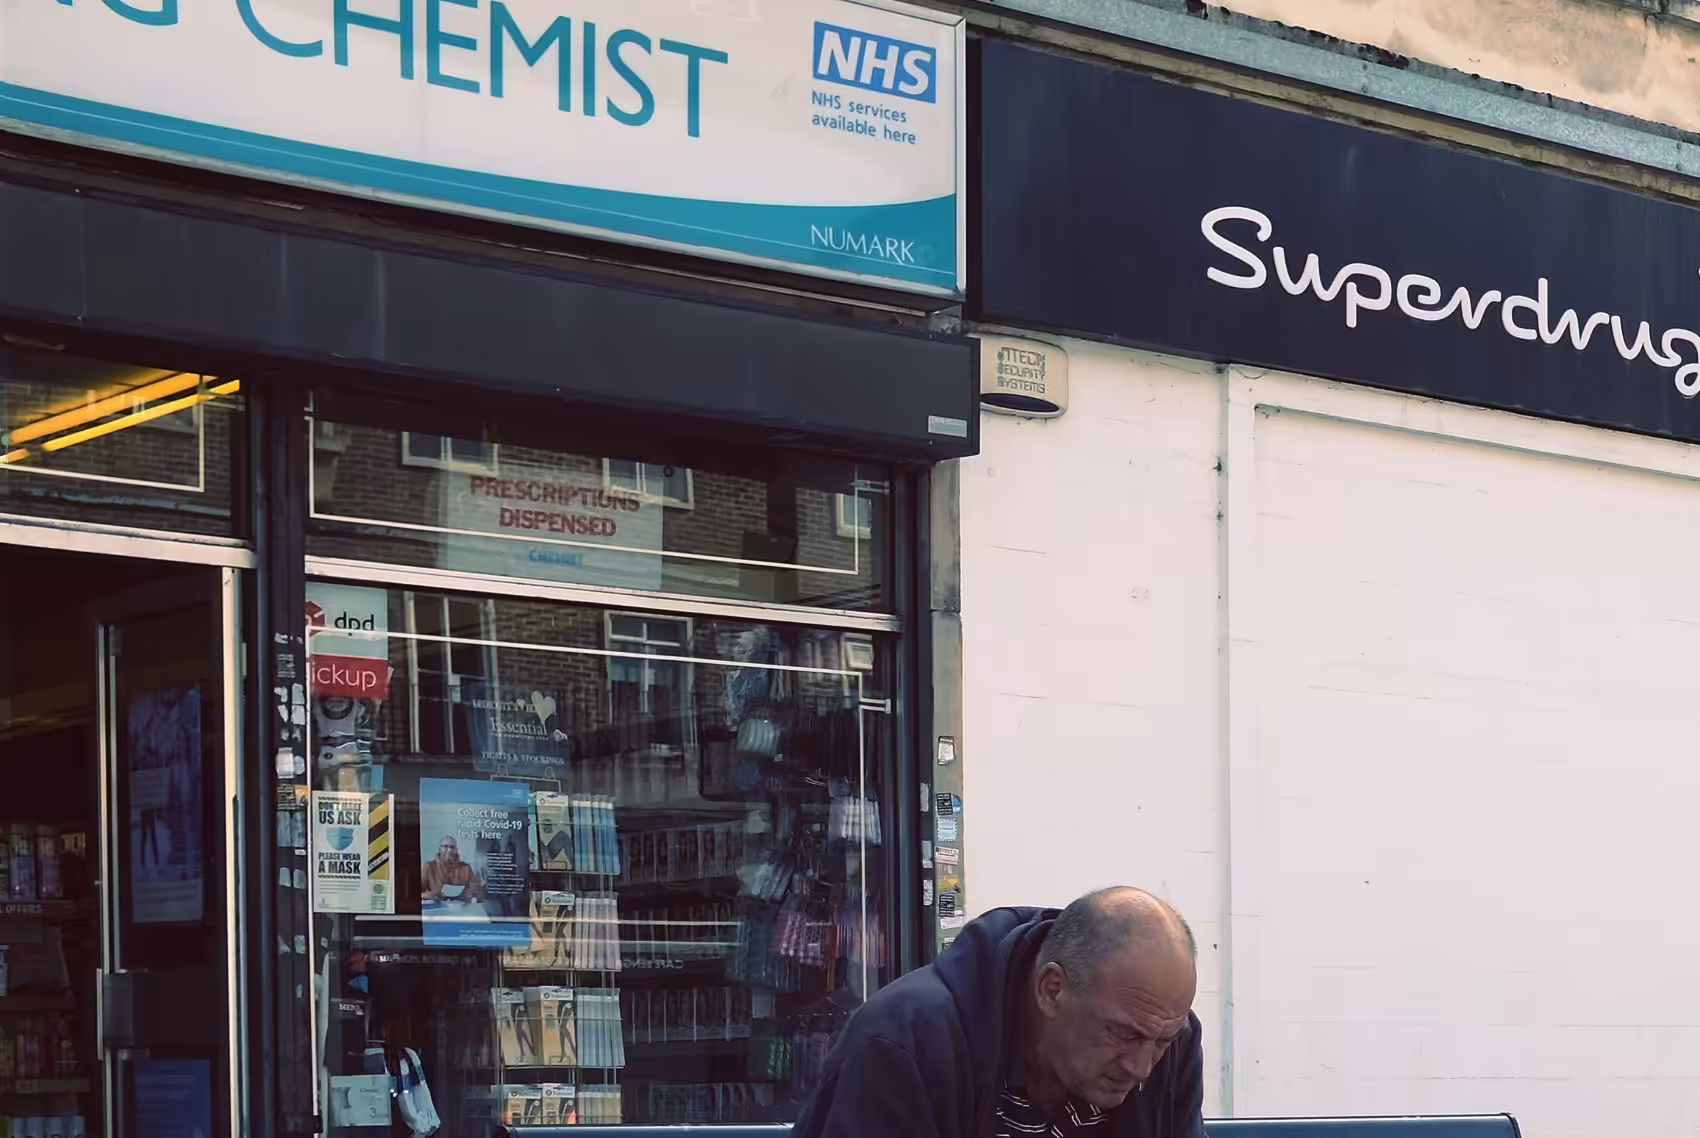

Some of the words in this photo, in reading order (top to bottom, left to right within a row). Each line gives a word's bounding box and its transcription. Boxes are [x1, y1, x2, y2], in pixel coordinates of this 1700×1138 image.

[236, 0, 729, 138] CHEMIST
[817, 30, 932, 95] NHS
[811, 91, 841, 109] NHS
[848, 99, 907, 123] services
[811, 111, 876, 137] available
[883, 123, 916, 144] here
[811, 224, 915, 265] NUMARK
[998, 376, 1045, 394] SYSTEMS
[470, 475, 641, 512] PRESCRIPTIONS
[500, 507, 617, 537] DISPENSED
[334, 611, 375, 636] dpd
[311, 662, 377, 691] ickup
[318, 811, 335, 825] US
[337, 812, 361, 825] ASK
[484, 819, 523, 830] Covid-19
[490, 808, 509, 819] free
[481, 829, 502, 839] here
[318, 862, 326, 873] A
[328, 862, 361, 874] MASK
[342, 853, 361, 861] WEAR
